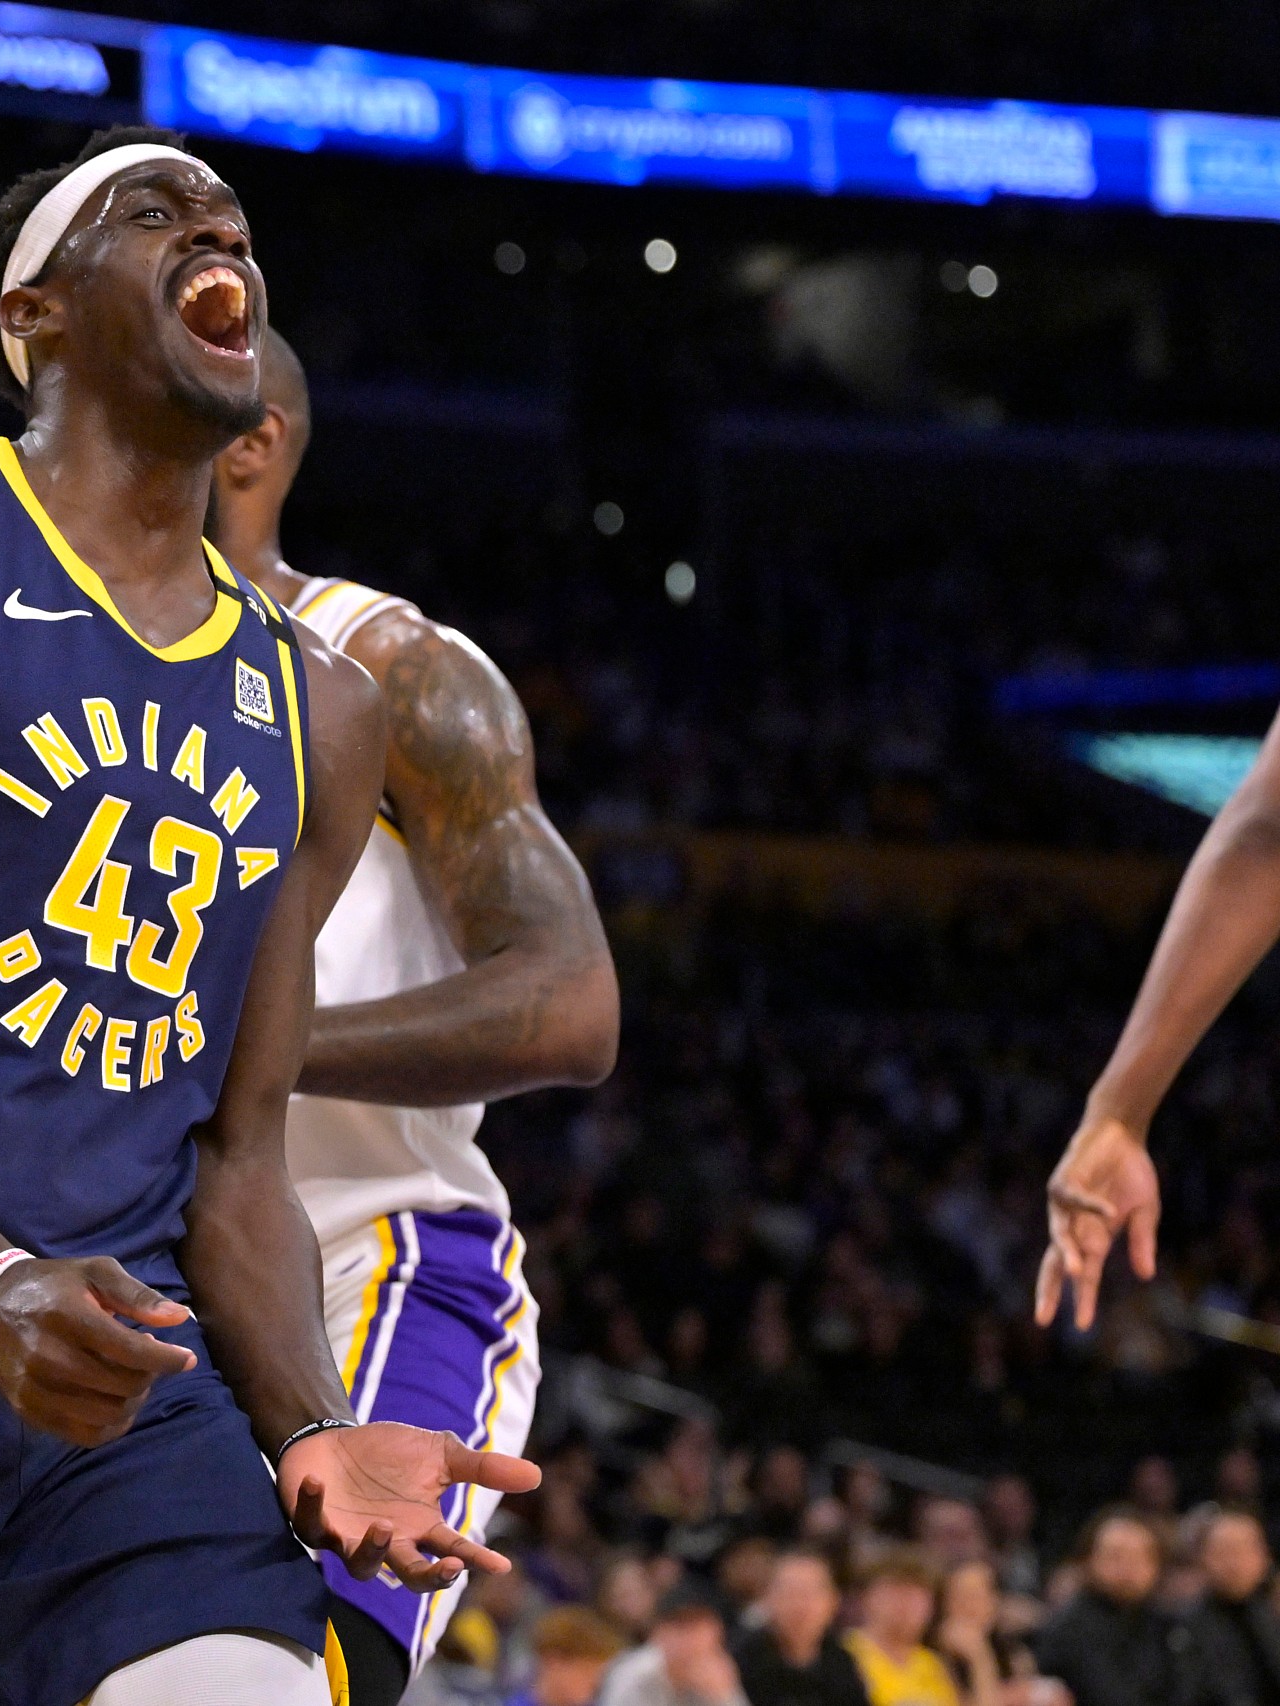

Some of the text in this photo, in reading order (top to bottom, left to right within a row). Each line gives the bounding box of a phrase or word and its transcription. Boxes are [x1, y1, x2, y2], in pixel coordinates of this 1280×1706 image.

[246, 596, 267, 626] 30
[233, 709, 282, 737] spokenote
[44, 794, 223, 998] 43
